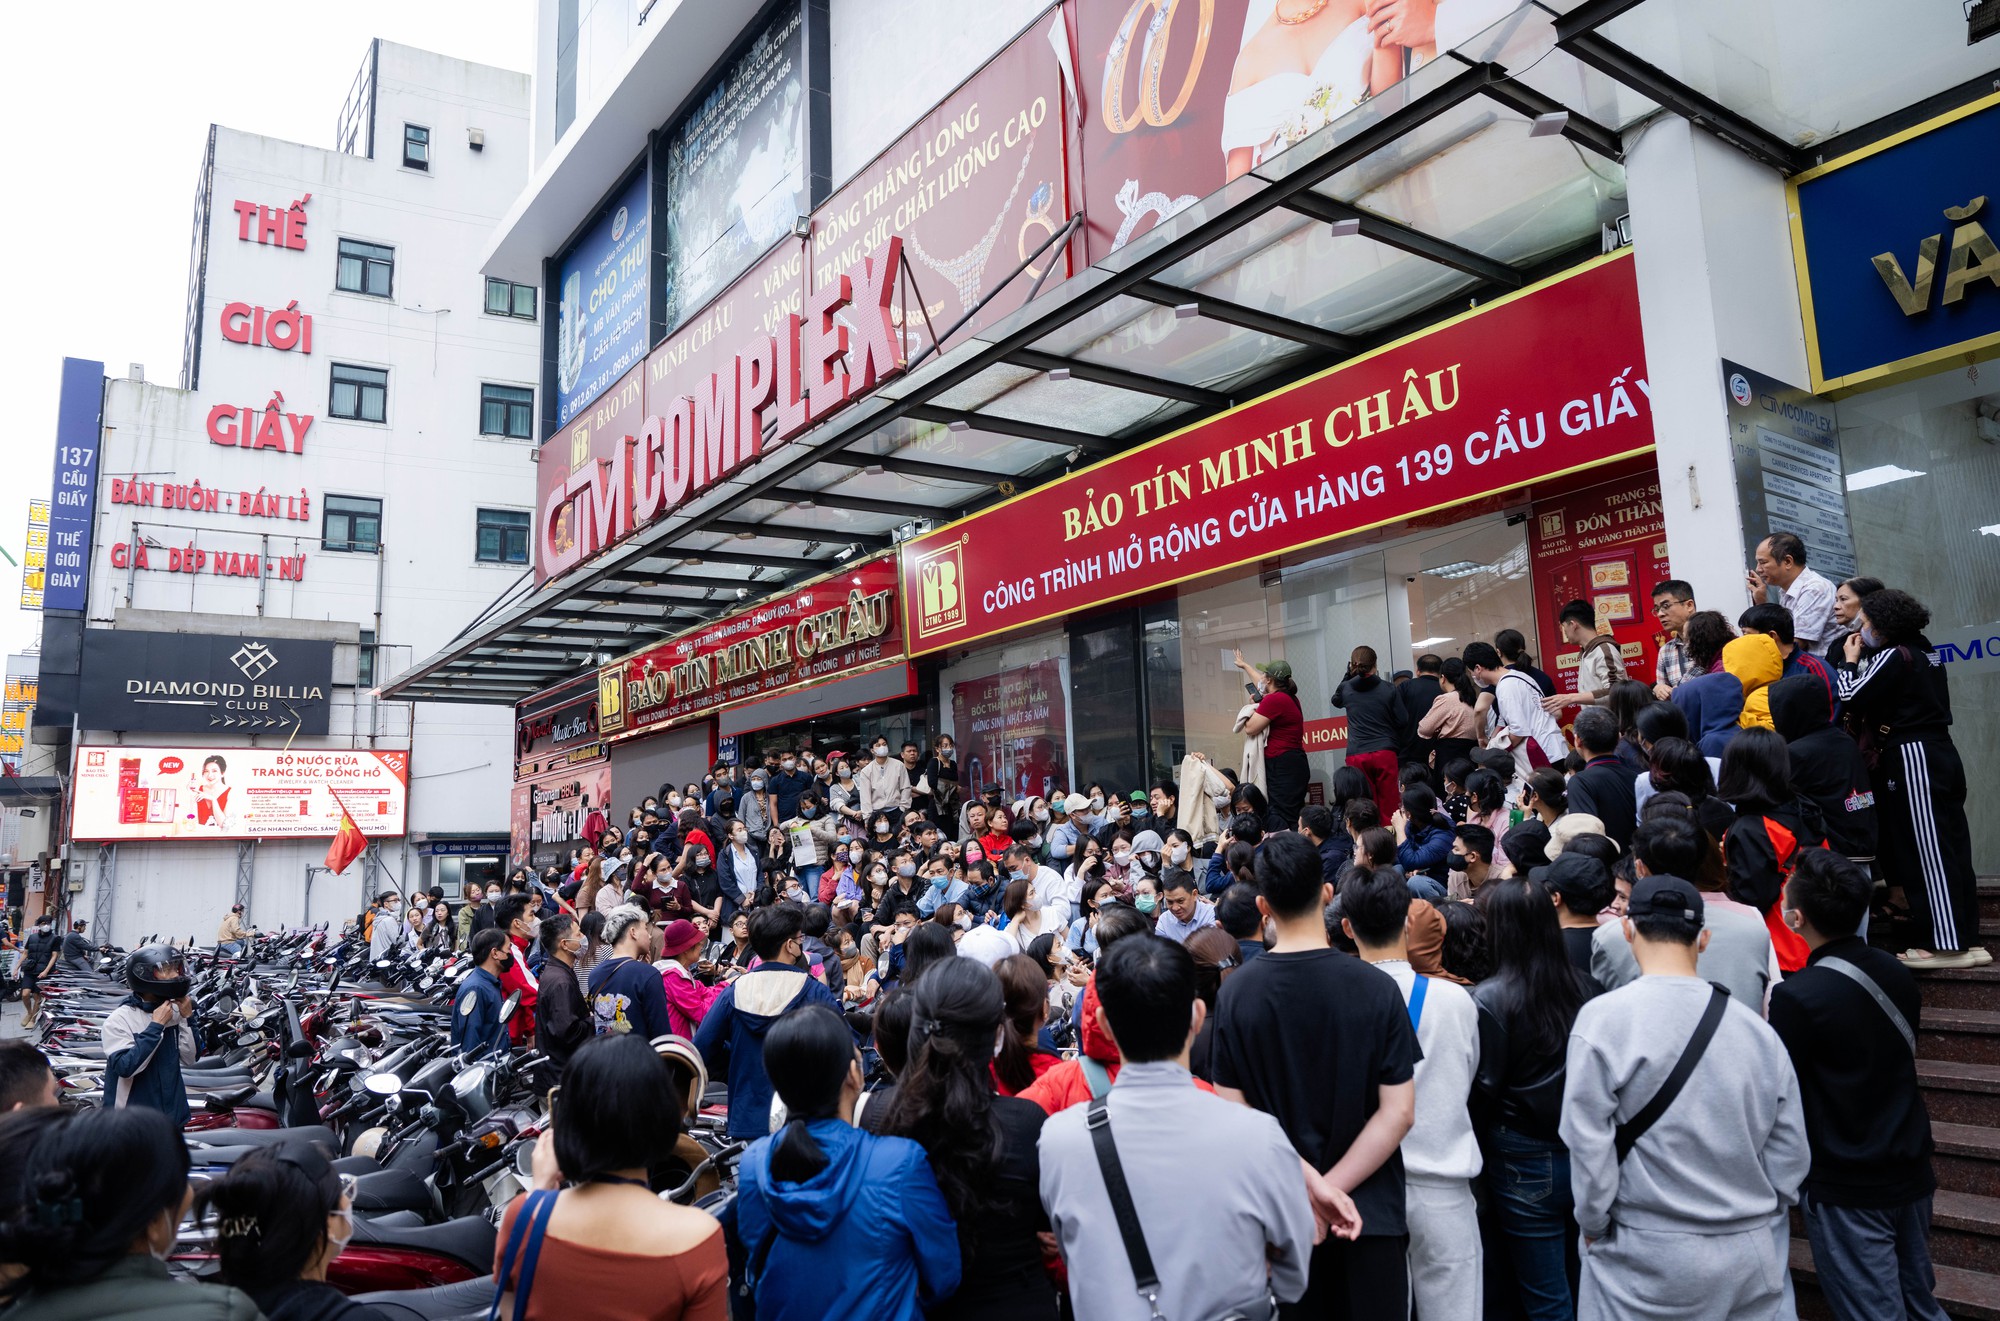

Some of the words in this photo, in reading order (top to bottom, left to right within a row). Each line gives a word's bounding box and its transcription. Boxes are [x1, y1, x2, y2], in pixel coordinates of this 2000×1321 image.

[686, 121, 704, 147] TRUNG
[774, 26, 788, 50] CTM
[741, 58, 792, 120] 0936.496.466
[816, 200, 860, 256] RỒNG
[863, 150, 922, 216] THĂNG
[926, 102, 980, 168] LONG
[816, 240, 862, 290] TRANG
[864, 217, 892, 257] SỨC
[894, 176, 937, 232] CHẤT
[939, 131, 1000, 201] LƯỢNG
[1003, 96, 1046, 149] CAO
[234, 193, 312, 252] THẾ
[1870, 195, 2000, 316] VĂ
[589, 269, 616, 314] CHO
[763, 252, 800, 298] VÀNG
[220, 300, 312, 354] GIỚI
[594, 319, 604, 337] MB
[605, 297, 620, 324] VĂN
[594, 336, 609, 362] CĂN
[610, 325, 621, 344] HỘ
[622, 305, 642, 335] DỊCH
[596, 396, 619, 431] BẢO
[622, 376, 640, 410] TÍN
[652, 337, 688, 385] MINH
[691, 300, 734, 353] CHÂU
[638, 236, 907, 520] COMPLEX
[570, 370, 609, 414] 0912.679.181
[206, 390, 314, 454] GIẦY
[1786, 403, 1831, 433] COMPLEX
[60, 446, 94, 467] 137
[1062, 488, 1124, 542] BẢO
[1130, 464, 1192, 518] TÍN
[1198, 418, 1316, 495] MINH
[1323, 363, 1461, 448] CHÂU
[62, 469, 87, 487] CẦU
[58, 490, 88, 507] GIẤY
[111, 472, 154, 506] BÁN
[162, 478, 218, 512] BUÔN
[239, 486, 280, 518] BÁN
[288, 488, 310, 520] LẺ
[982, 579, 1036, 614] CÔNG
[1040, 556, 1102, 596] TRÌNH
[1108, 533, 1143, 576] MỞ
[1150, 517, 1220, 564] RỘNG
[1228, 492, 1288, 538] CỬA
[1294, 464, 1385, 519] HÀNG
[1396, 443, 1454, 487] 139
[1464, 408, 1546, 466] CẦU
[1605, 488, 1646, 506] TRANG
[1575, 512, 1612, 534] ĐÓN
[1614, 500, 1664, 524] THẦN
[56, 530, 84, 547] THẾ
[1538, 550, 1554, 558] MINH
[1555, 544, 1572, 555] CHÂU
[1542, 542, 1556, 550] BẢO
[1557, 538, 1567, 546] TÍN
[1578, 537, 1596, 549] SẮM
[1598, 530, 1622, 544] VÀNG
[1624, 524, 1648, 538] THẦN
[54, 551, 80, 568] GIỚI
[168, 540, 206, 574] DÉP
[214, 550, 260, 578] NAM
[50, 572, 80, 588] GIÀY
[926, 614, 942, 627] BTMC
[944, 608, 959, 622] 1989
[628, 663, 671, 714] BẢO
[671, 650, 713, 698] TÍN
[714, 625, 794, 685] MINH
[795, 588, 893, 658] CHÂU
[676, 640, 692, 656] CÔNG
[694, 637, 702, 648] TY
[736, 620, 750, 632] BẠC
[1623, 646, 1639, 654] NHỎ
[126, 680, 245, 698] DIAMOND
[253, 684, 324, 700] BILLIA
[636, 714, 650, 726] KINH
[650, 708, 668, 722] DOANH
[694, 696, 713, 710] TRANG
[714, 688, 726, 702] SỨC
[729, 684, 745, 698] VÀNG
[746, 682, 760, 695] BẠC
[765, 674, 775, 688] ĐÁ
[775, 670, 790, 685] QUÝ
[798, 667, 810, 678] KIM
[812, 658, 838, 674] CƯƠNG
[844, 650, 856, 665] MỸ
[859, 642, 880, 660] NGHỆ
[225, 700, 269, 710] CLUB
[972, 703, 987, 716] BỐC
[1010, 696, 1028, 708] MAY
[1030, 688, 1048, 704] MẮN
[990, 716, 1004, 730] SINH
[1006, 710, 1024, 726] NHẬT
[1024, 710, 1032, 722] 36
[1033, 705, 1049, 718] NĂM
[572, 716, 588, 738] Box
[252, 768, 294, 777] TRANG
[296, 766, 322, 778] SỨC,
[326, 766, 360, 778] ĐỒNG
[364, 766, 381, 778] HỒ
[276, 754, 294, 766] BỘ
[296, 756, 332, 766] NƯỚC
[334, 754, 358, 766] RỬA
[380, 753, 404, 772] MỚI
[560, 783, 574, 799] BBQ
